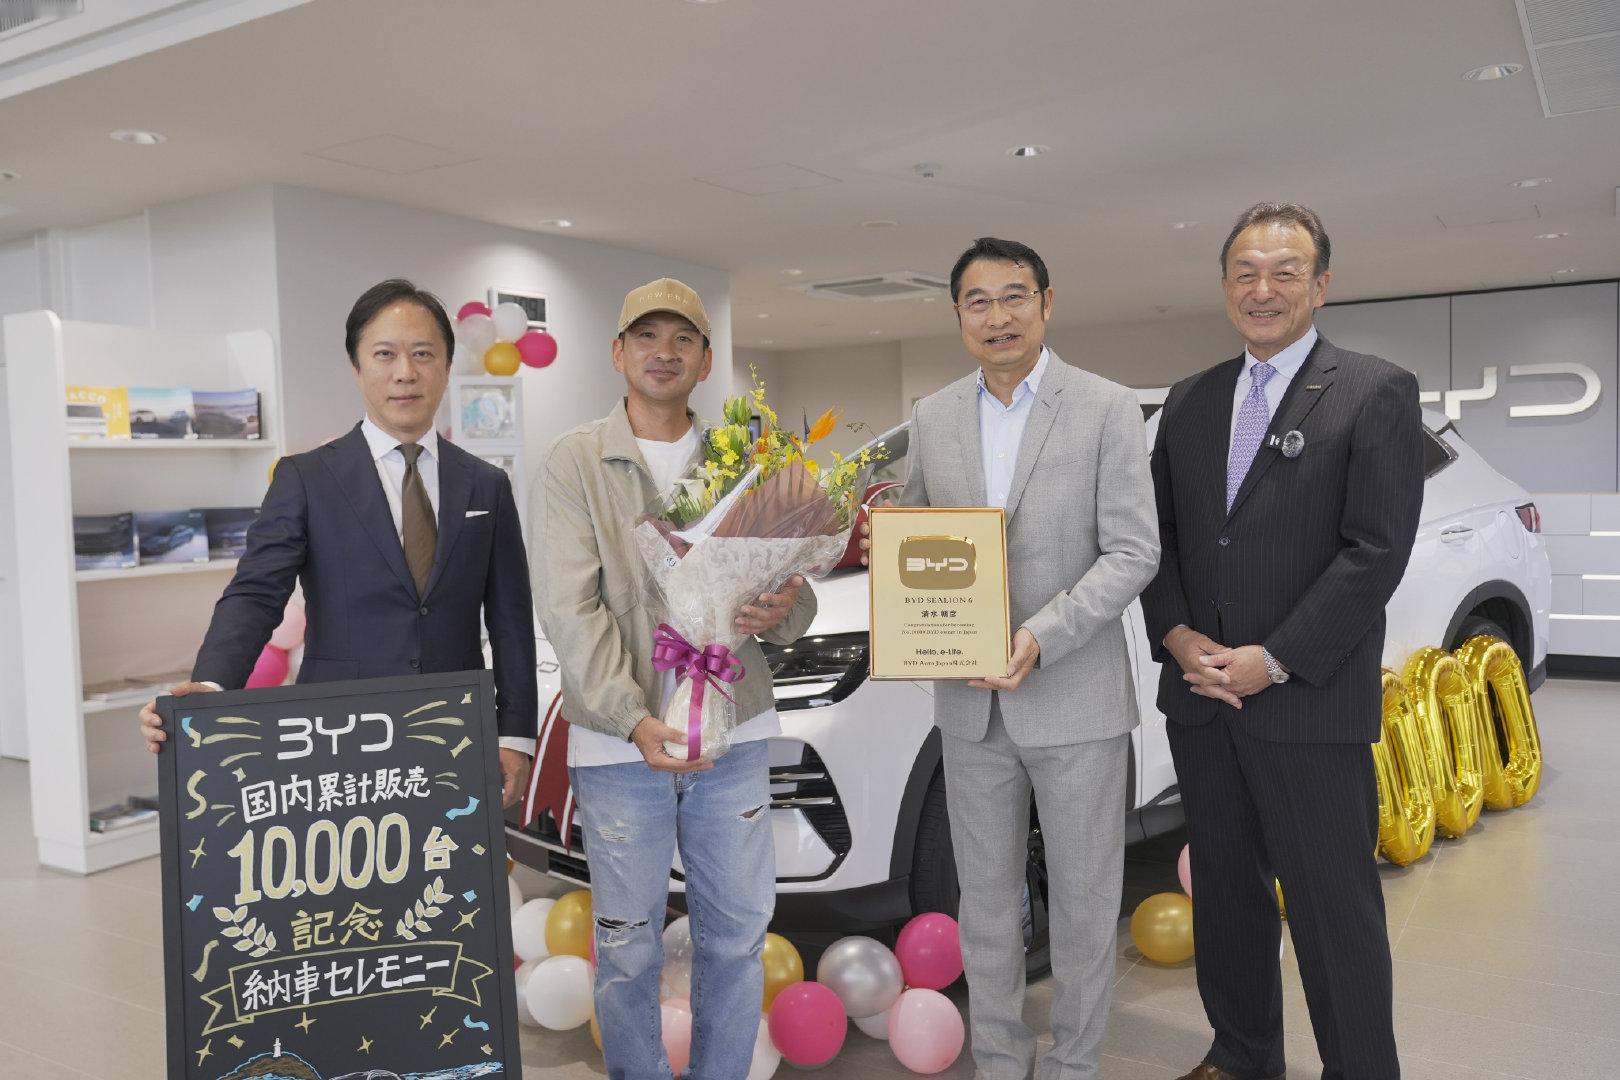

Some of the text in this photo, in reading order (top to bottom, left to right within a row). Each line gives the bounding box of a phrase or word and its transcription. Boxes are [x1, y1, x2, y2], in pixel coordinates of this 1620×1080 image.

[639, 291, 663, 304] NEW
[1419, 362, 1602, 421] YD
[906, 557, 969, 572] BYD
[904, 596, 974, 604] BYD SEALION 6
[277, 713, 394, 760] BYD
[241, 765, 431, 824] 国内累計販売
[291, 901, 383, 951] 記念
[241, 954, 451, 1011] 納車セレモニー
